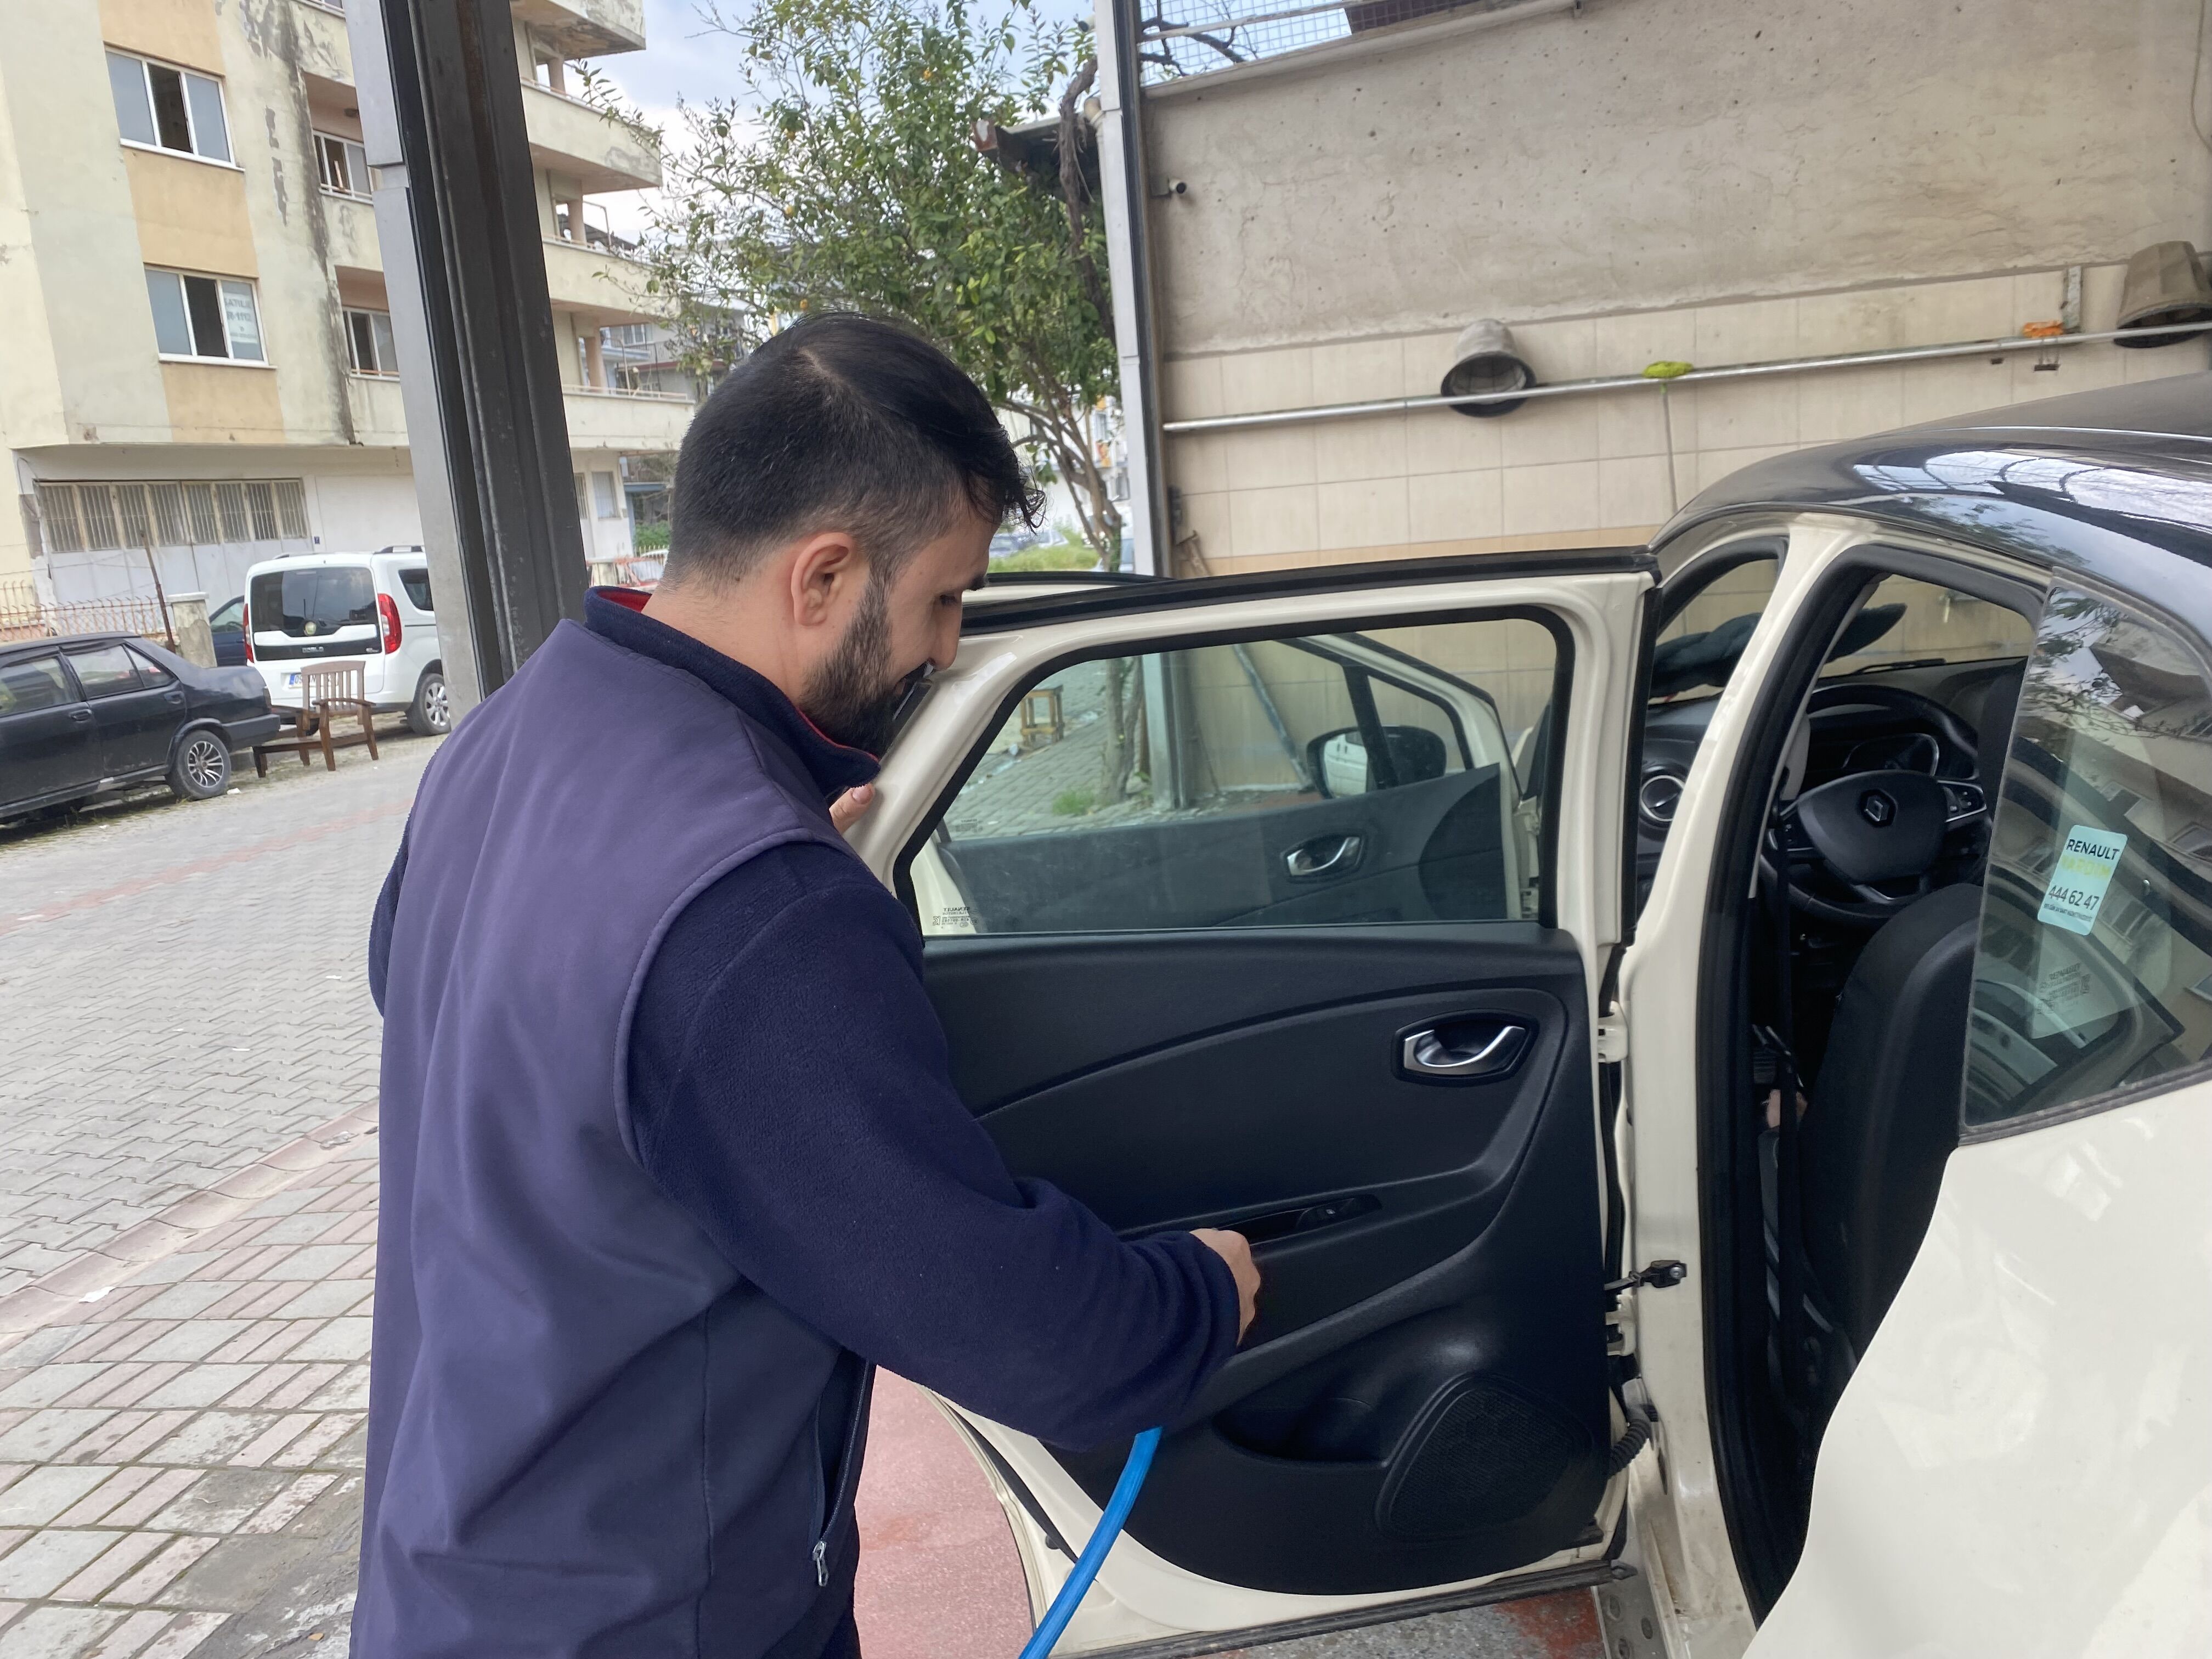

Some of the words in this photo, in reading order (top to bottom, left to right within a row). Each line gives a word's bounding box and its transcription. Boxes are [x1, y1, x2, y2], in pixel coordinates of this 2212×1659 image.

[2066, 839, 2120, 860] RENAULT
[2048, 885, 2069, 902] 444
[2068, 890, 2084, 906] 62
[2084, 895, 2100, 911] 47
